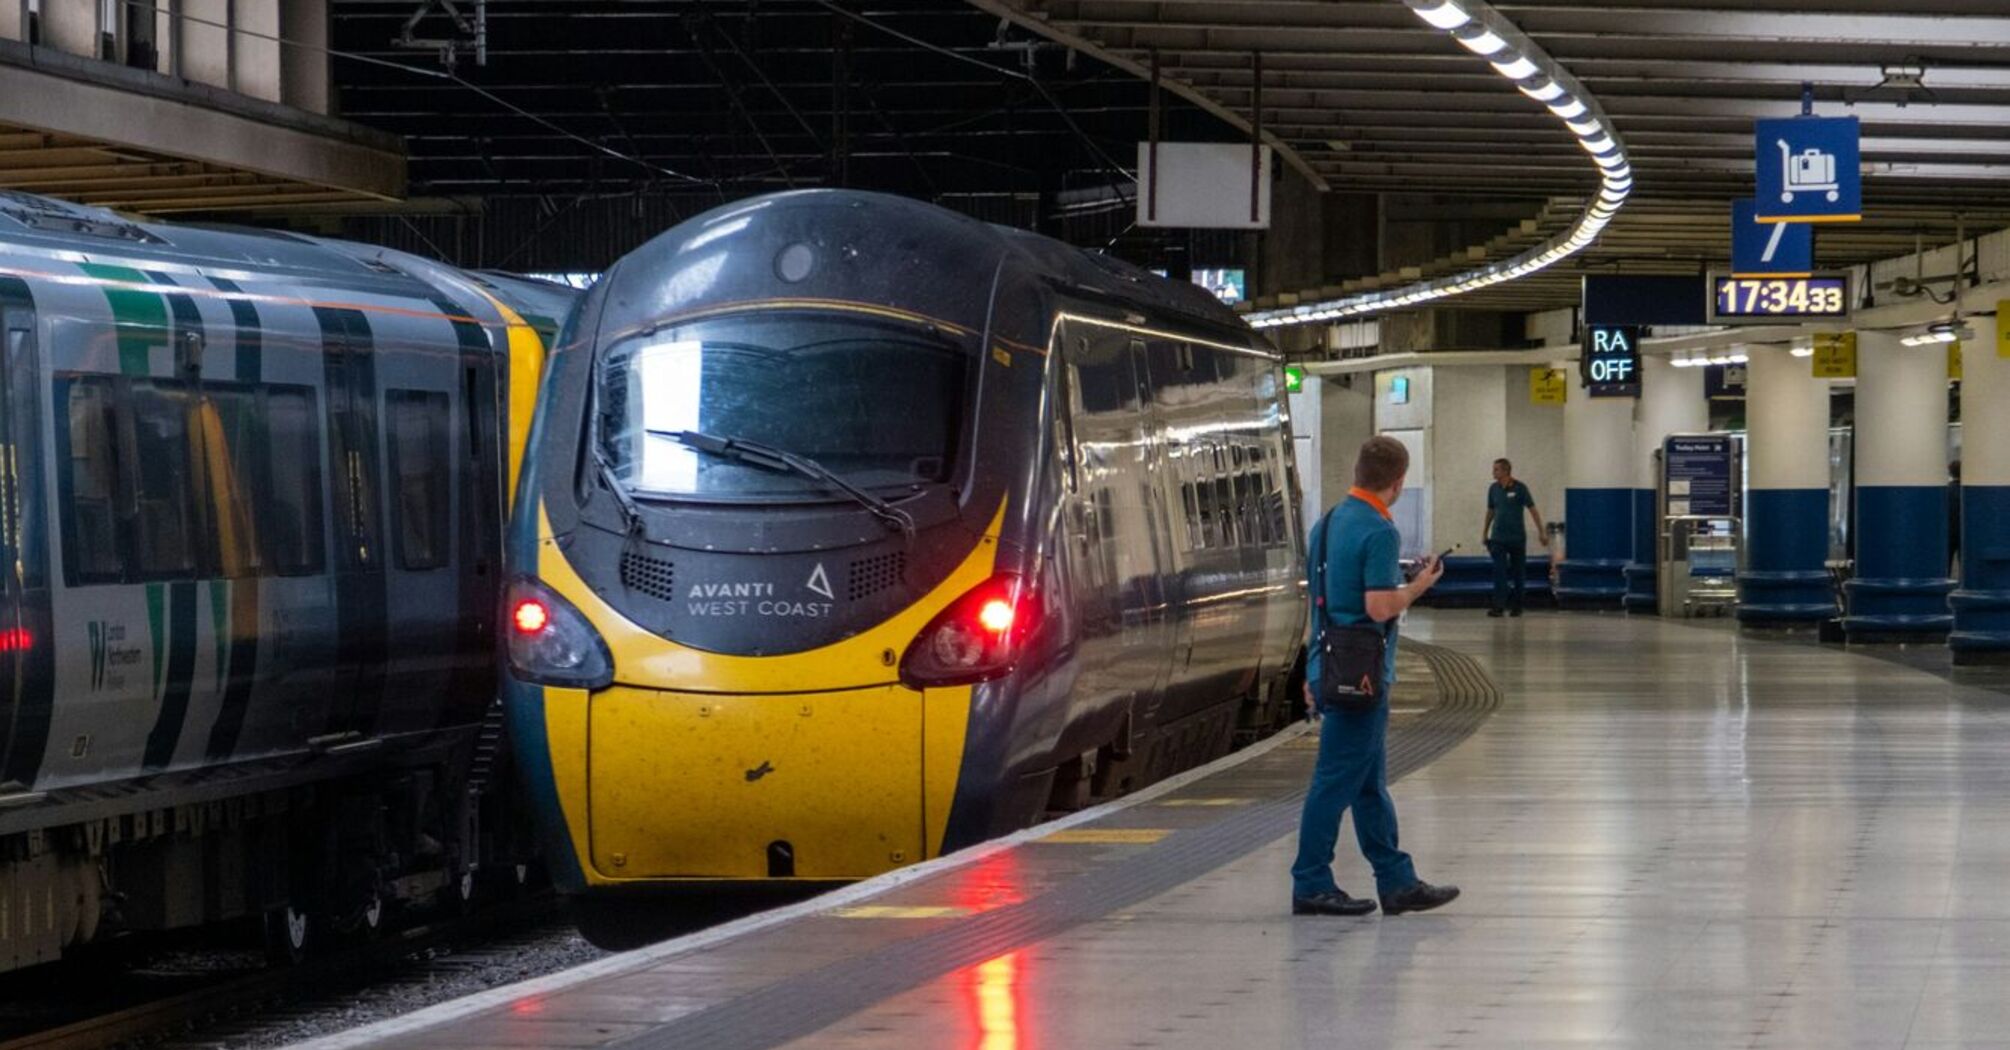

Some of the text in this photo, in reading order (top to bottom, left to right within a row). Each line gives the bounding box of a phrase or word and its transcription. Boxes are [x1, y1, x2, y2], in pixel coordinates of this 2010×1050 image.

[1594, 330, 1628, 352] RA
[1591, 359, 1632, 381] OFF
[688, 583, 773, 598] AVANTI
[688, 601, 833, 617] WEST COAST
